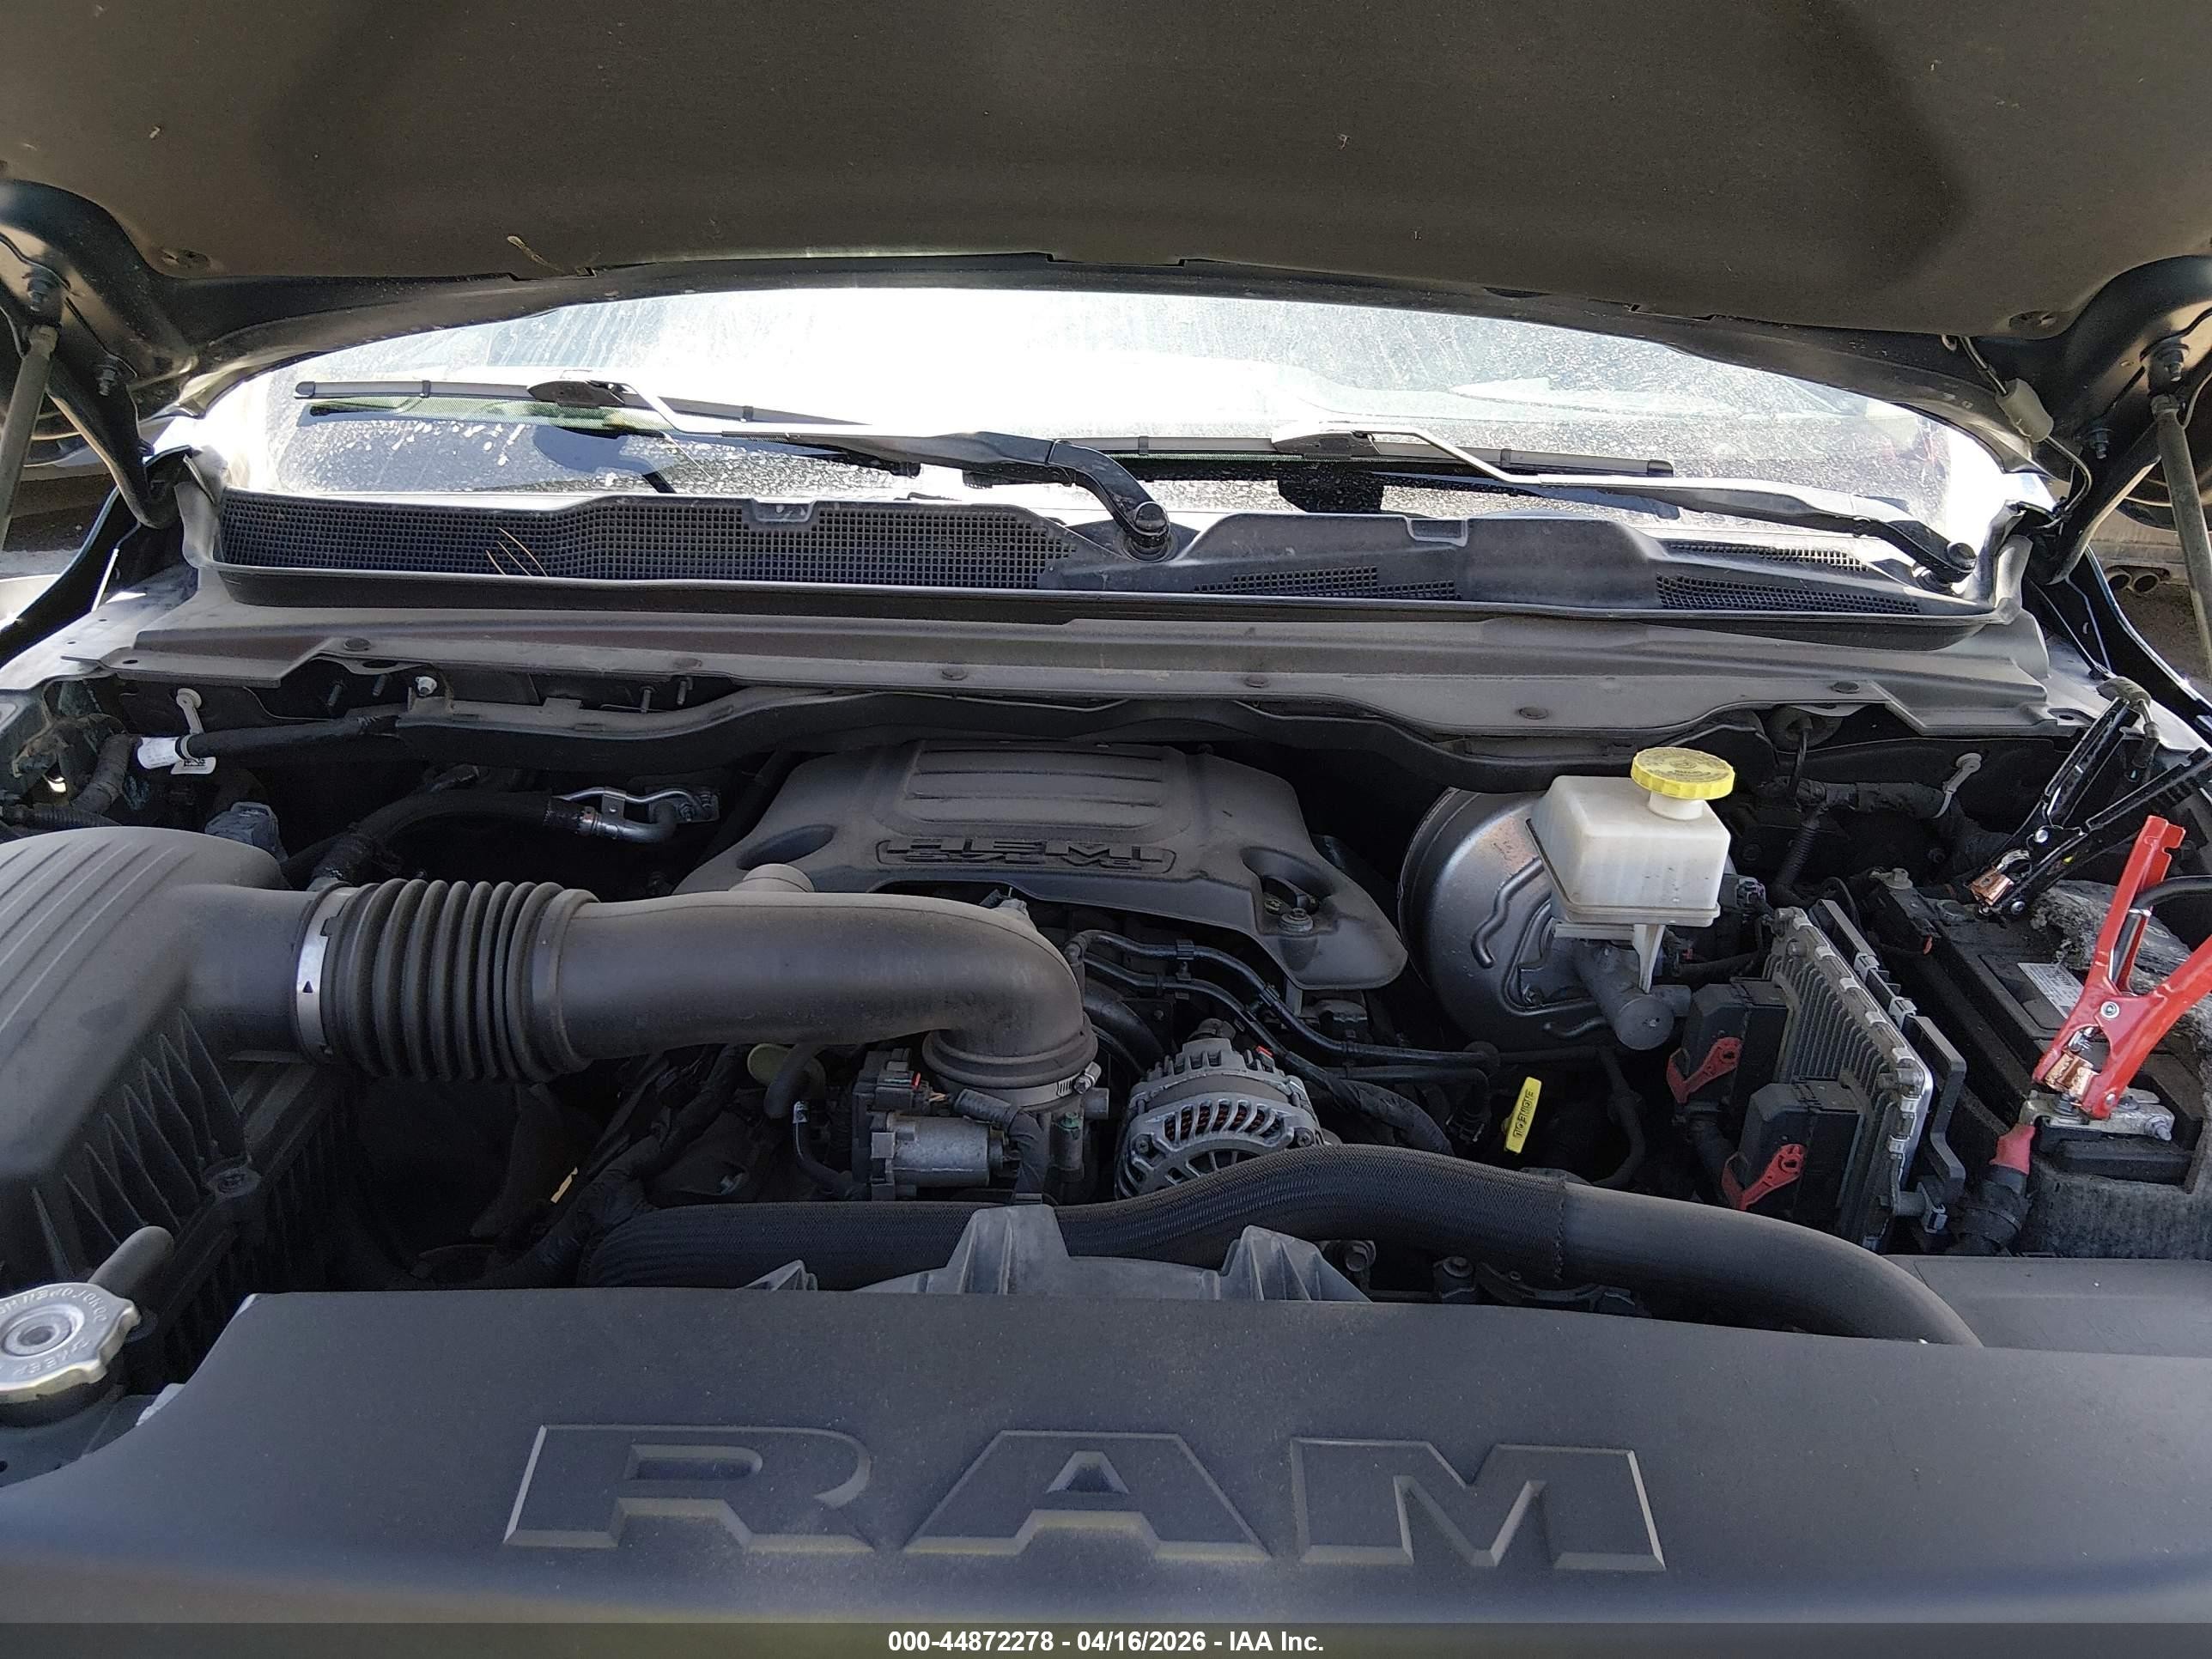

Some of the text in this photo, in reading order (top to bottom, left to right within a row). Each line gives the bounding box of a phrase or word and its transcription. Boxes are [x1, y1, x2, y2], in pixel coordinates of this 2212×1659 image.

[1513, 1089, 1534, 1138] ENGINE OIL
[23, 1287, 74, 1304] OPEN
[501, 1424, 1668, 1572] RAM
